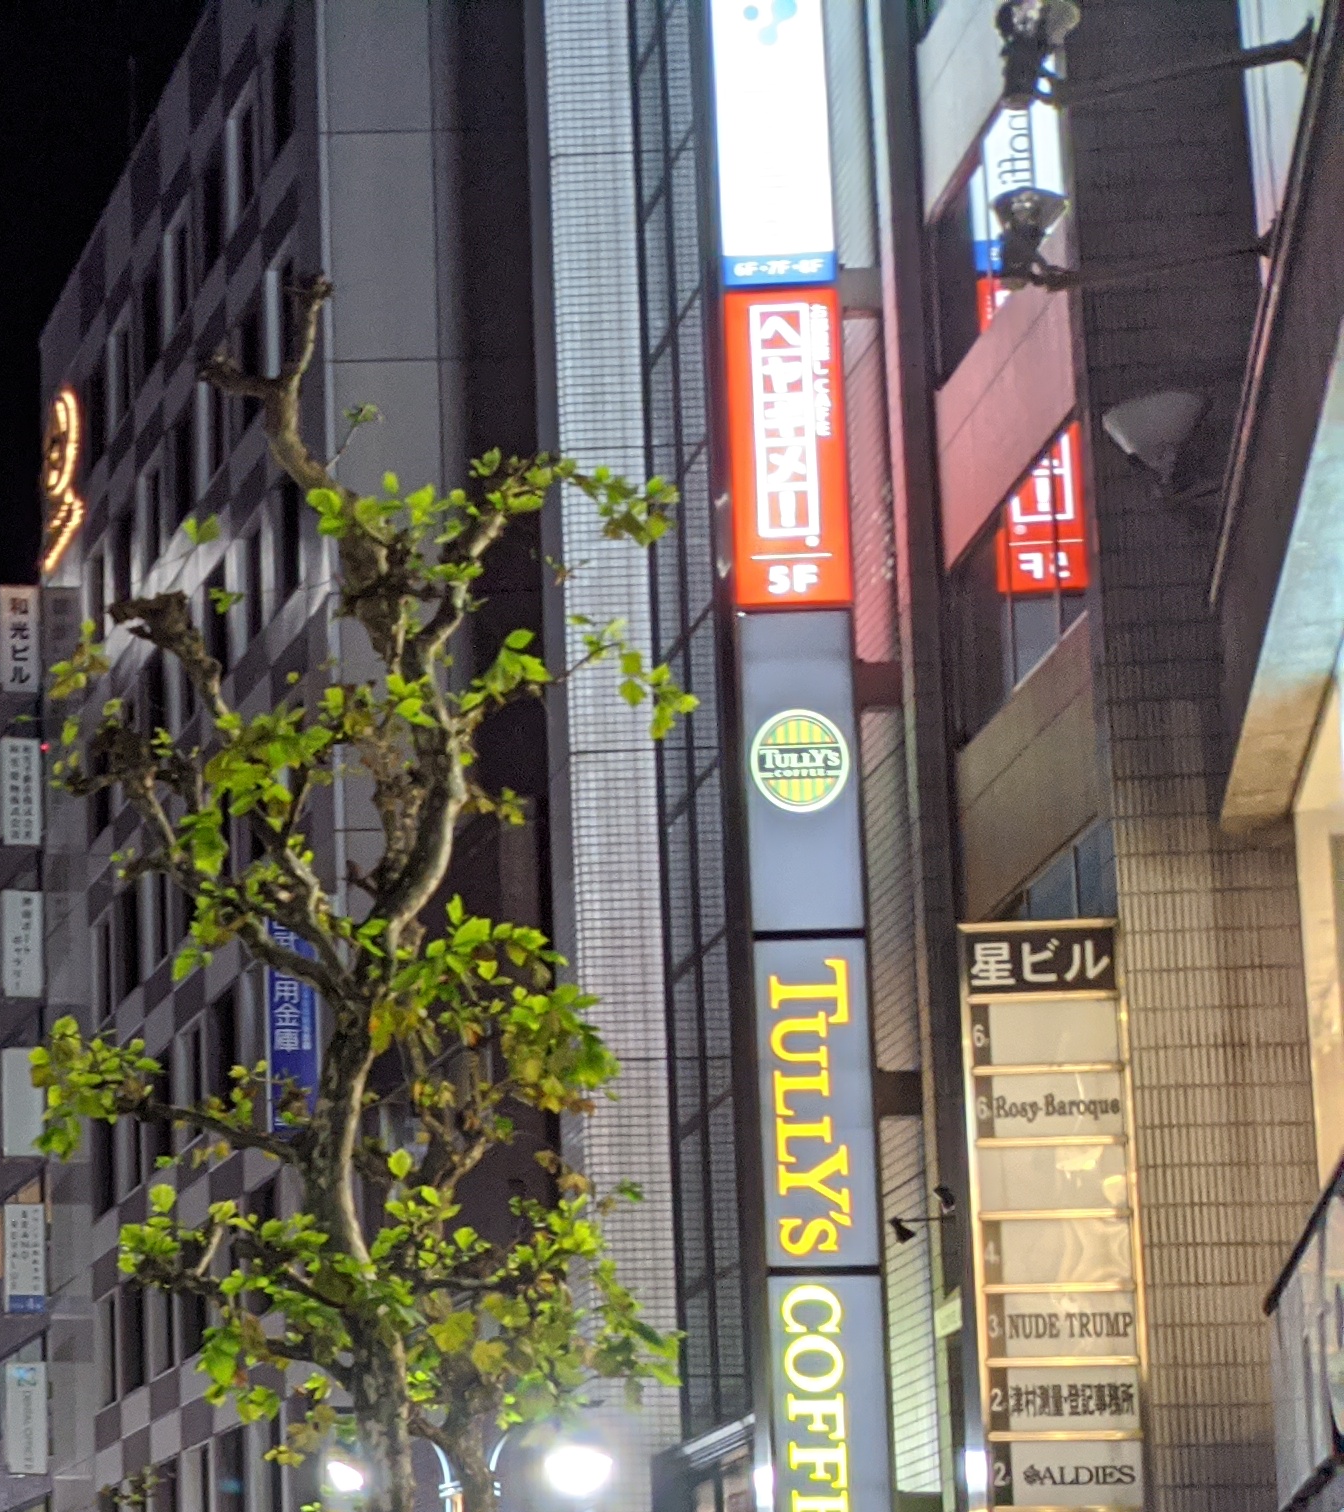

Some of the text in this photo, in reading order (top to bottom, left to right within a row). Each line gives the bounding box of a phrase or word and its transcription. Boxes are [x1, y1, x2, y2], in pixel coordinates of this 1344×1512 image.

[768, 564, 818, 594] 5F
[759, 748, 841, 769] TULLY'S
[971, 938, 1110, 987] 星ビル
[768, 959, 852, 1258] TULLY'S
[1008, 1312, 1060, 1339] NUDE
[1065, 1311, 1134, 1338] TRUMP
[1039, 1465, 1136, 1486] ALDIES
